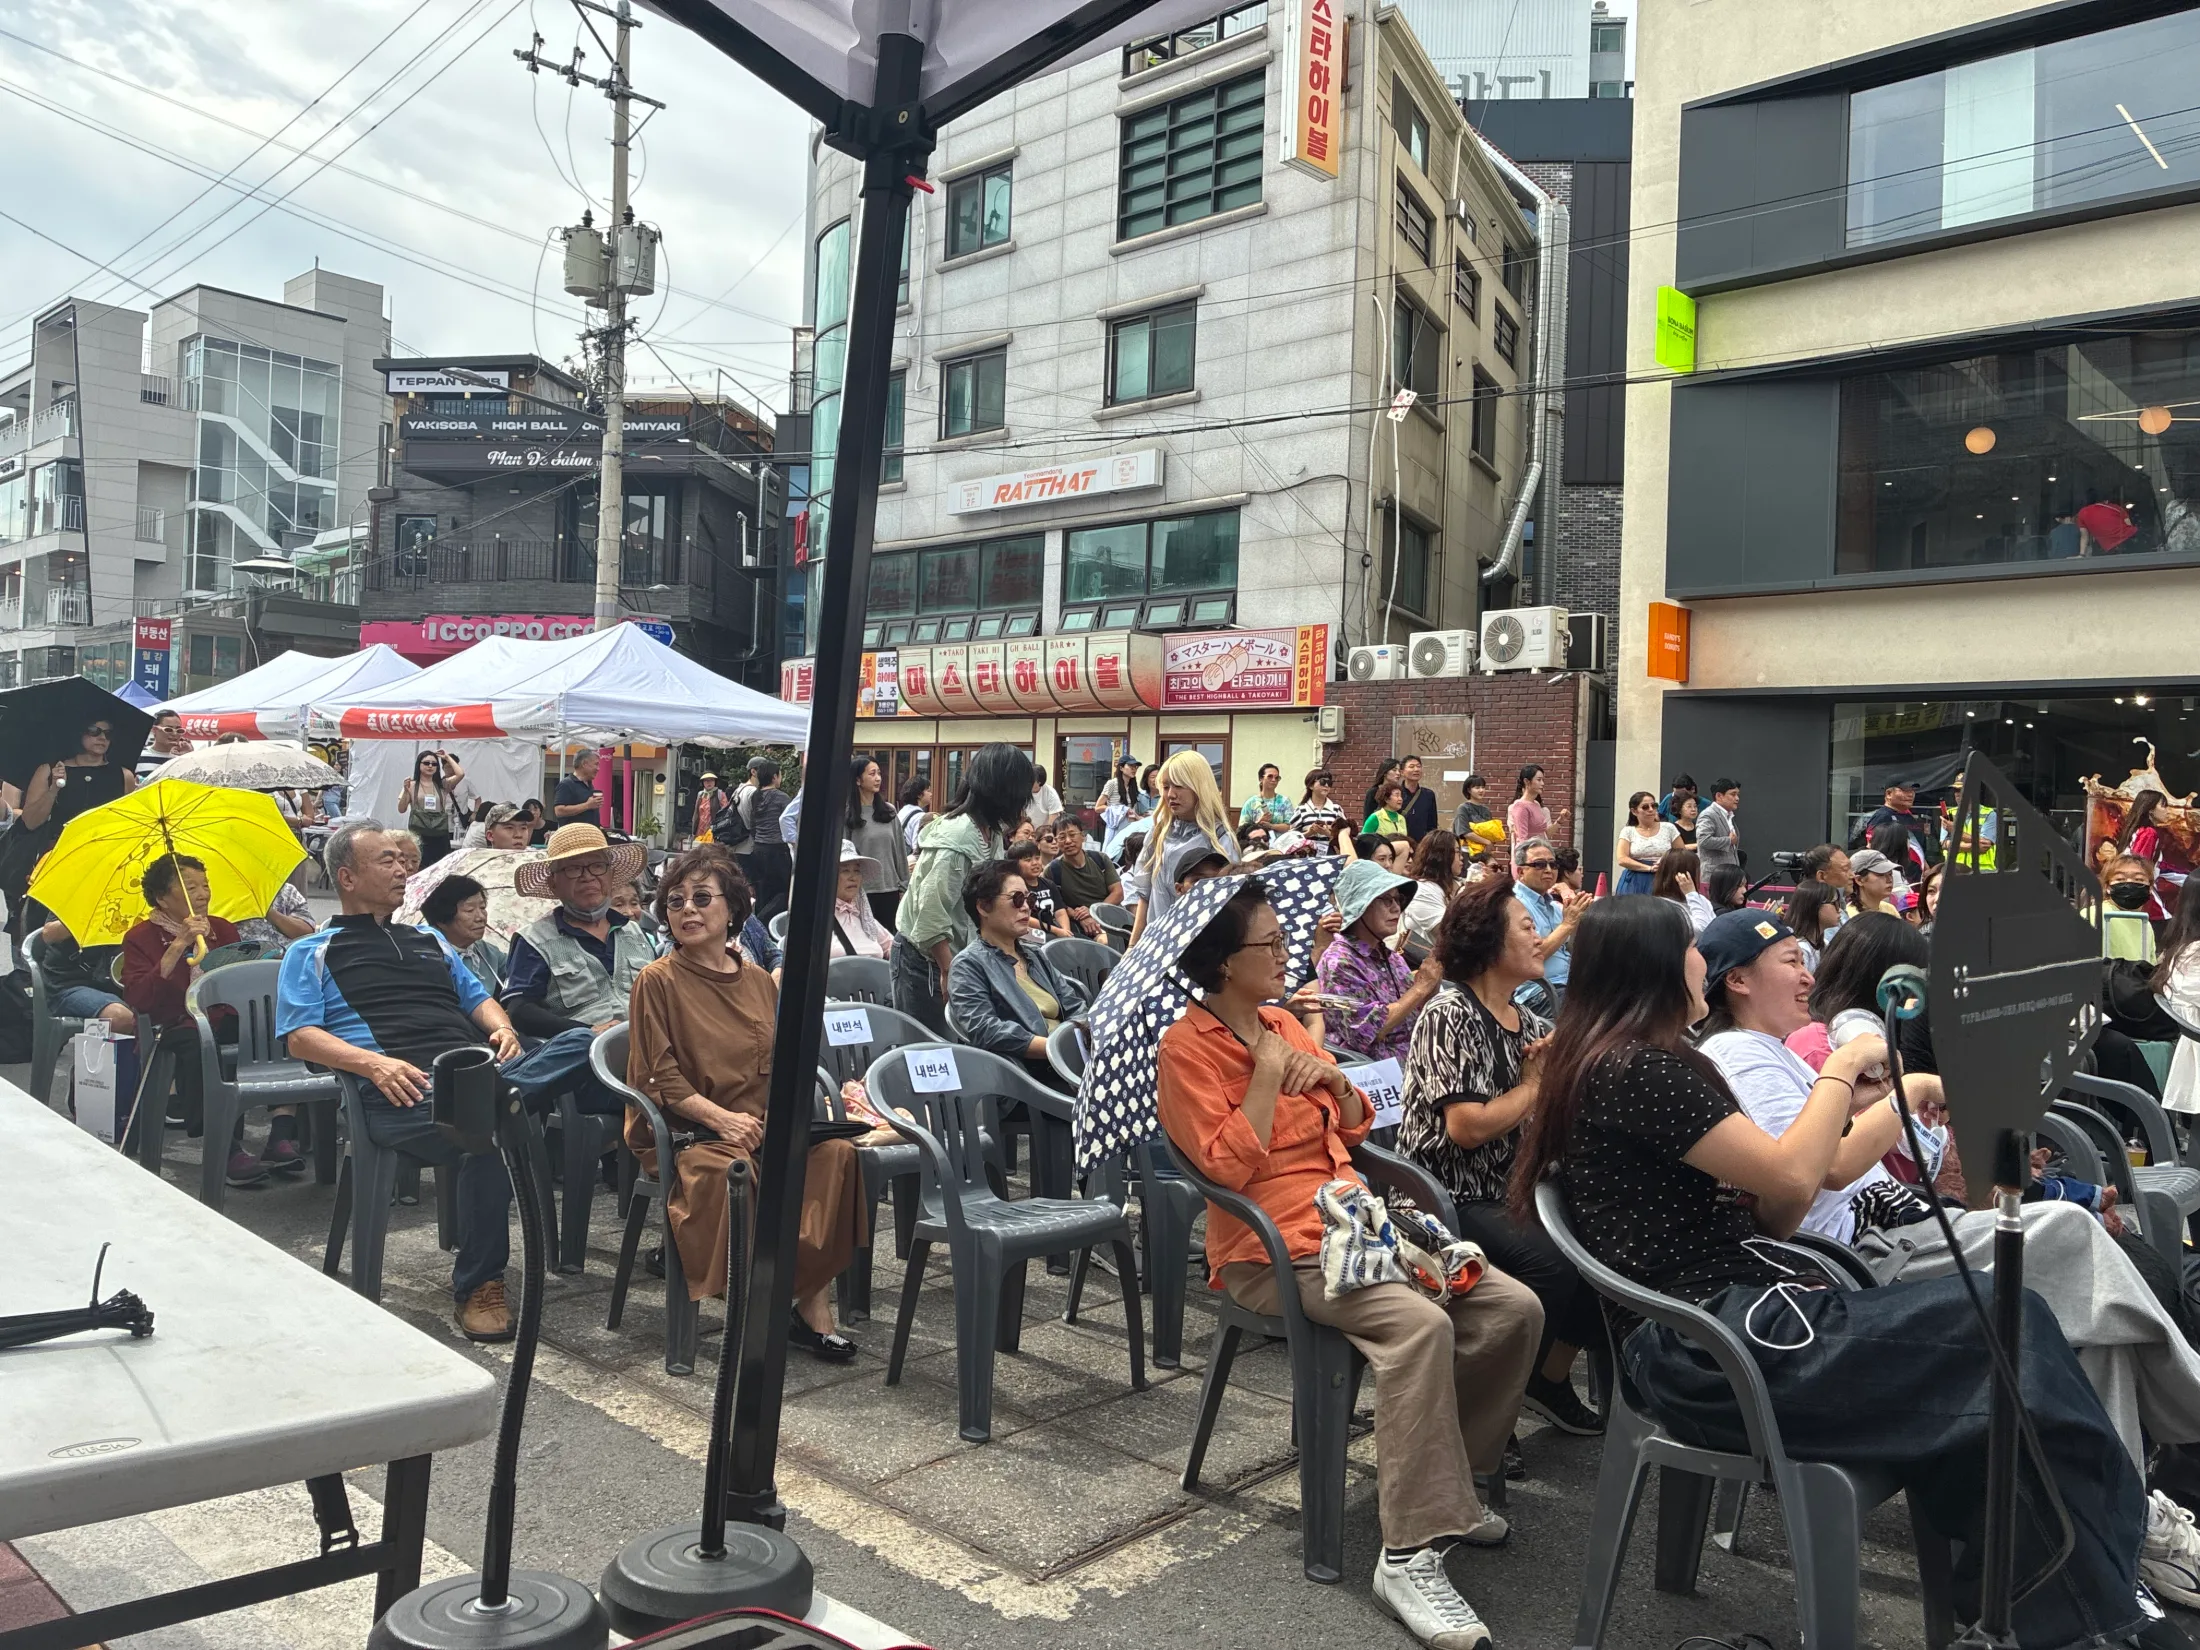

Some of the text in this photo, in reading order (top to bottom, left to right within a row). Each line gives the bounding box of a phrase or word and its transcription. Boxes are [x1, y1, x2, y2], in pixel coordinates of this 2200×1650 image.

[396, 377, 456, 386] TEPPAN
[408, 421, 478, 430] YAKISOBA
[492, 421, 527, 431] HIGH
[530, 421, 568, 431] BALL
[487, 450, 523, 466] Man
[550, 450, 593, 467] Salon
[993, 469, 1098, 505] RATTHAT
[139, 625, 168, 641] 부동산
[1050, 641, 1064, 650] BAR
[1314, 628, 1326, 677] 타코야끼
[877, 657, 897, 668] 생맥주
[1298, 629, 1310, 702] 마스타하이볼
[144, 663, 160, 692] 돼지
[905, 654, 1122, 698] 마스타하이볼
[1169, 673, 1288, 690] 최고의 타코야끼!!
[1206, 692, 1239, 700] HIGHBALL
[367, 711, 457, 733] 축제추진위원회
[832, 1020, 863, 1033] 내빈석
[915, 1063, 950, 1077] 내빈석
